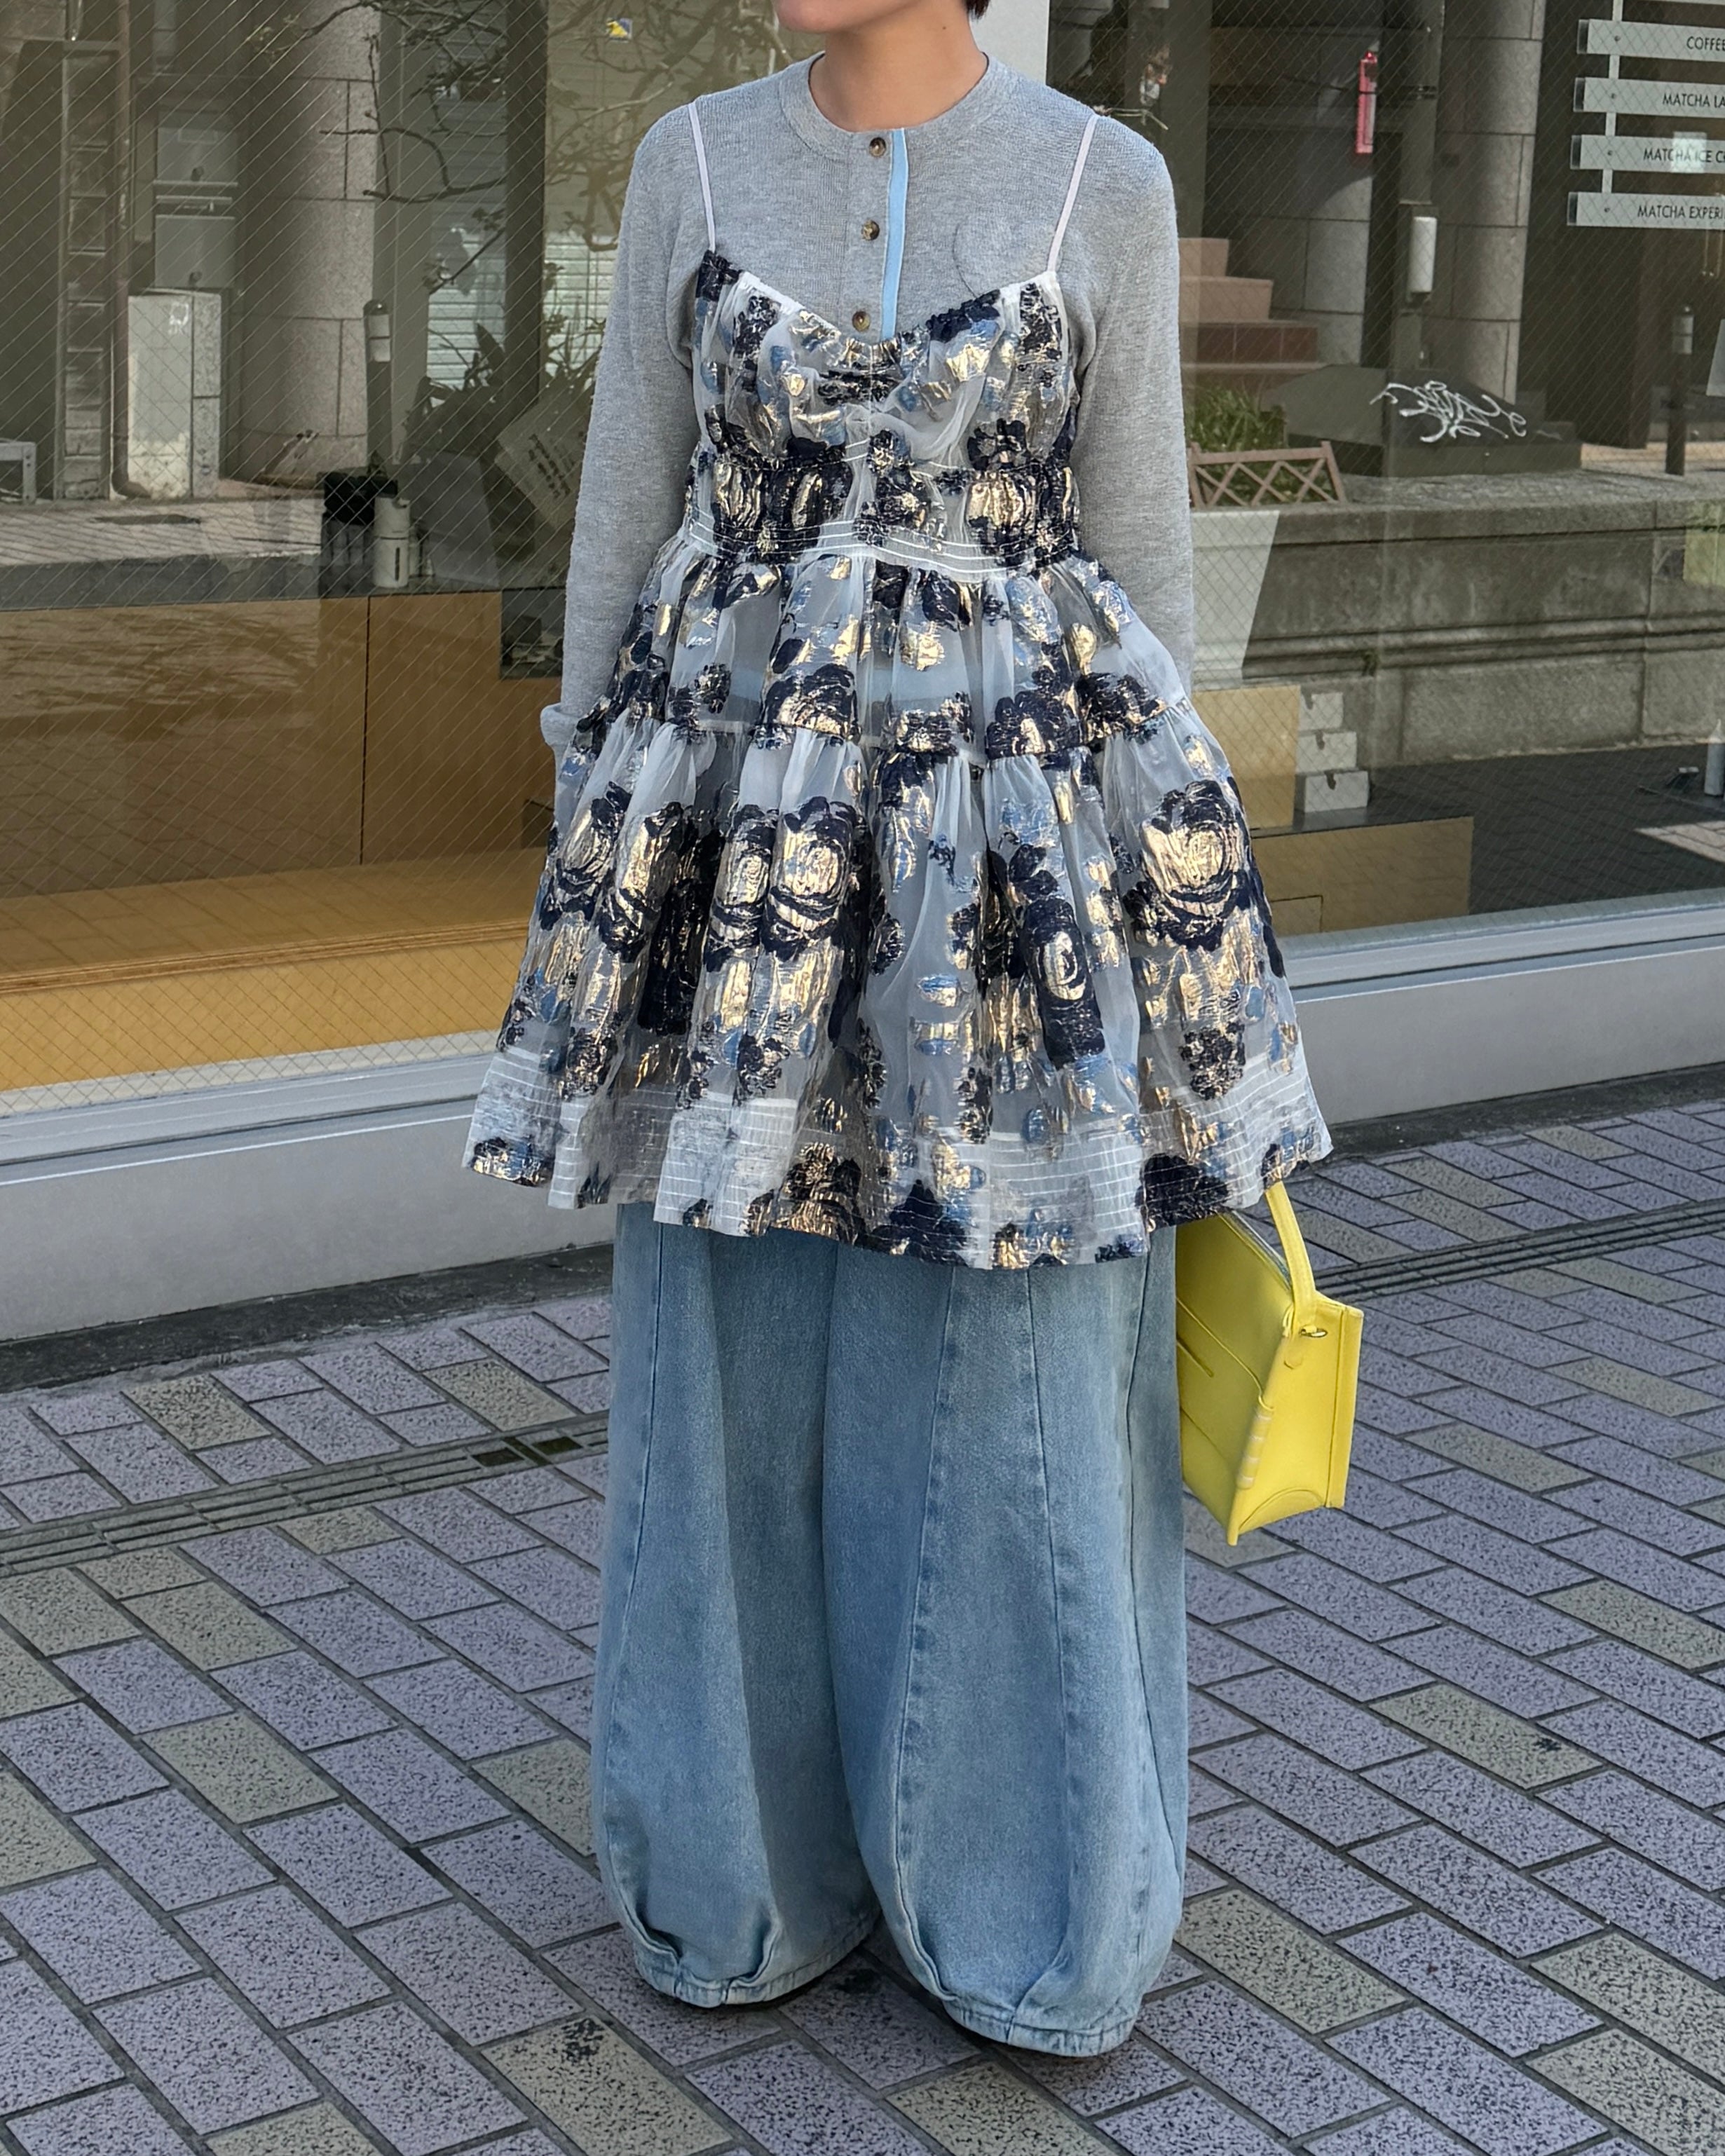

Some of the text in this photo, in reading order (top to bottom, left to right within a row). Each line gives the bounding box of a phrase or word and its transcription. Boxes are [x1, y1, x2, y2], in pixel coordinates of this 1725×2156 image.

[1686, 36, 1725, 51] COFFEE
[1663, 93, 1710, 107] MATCHA
[1643, 148, 1725, 163] MATCHA ICE C
[1637, 205, 1686, 218] MATCHA
